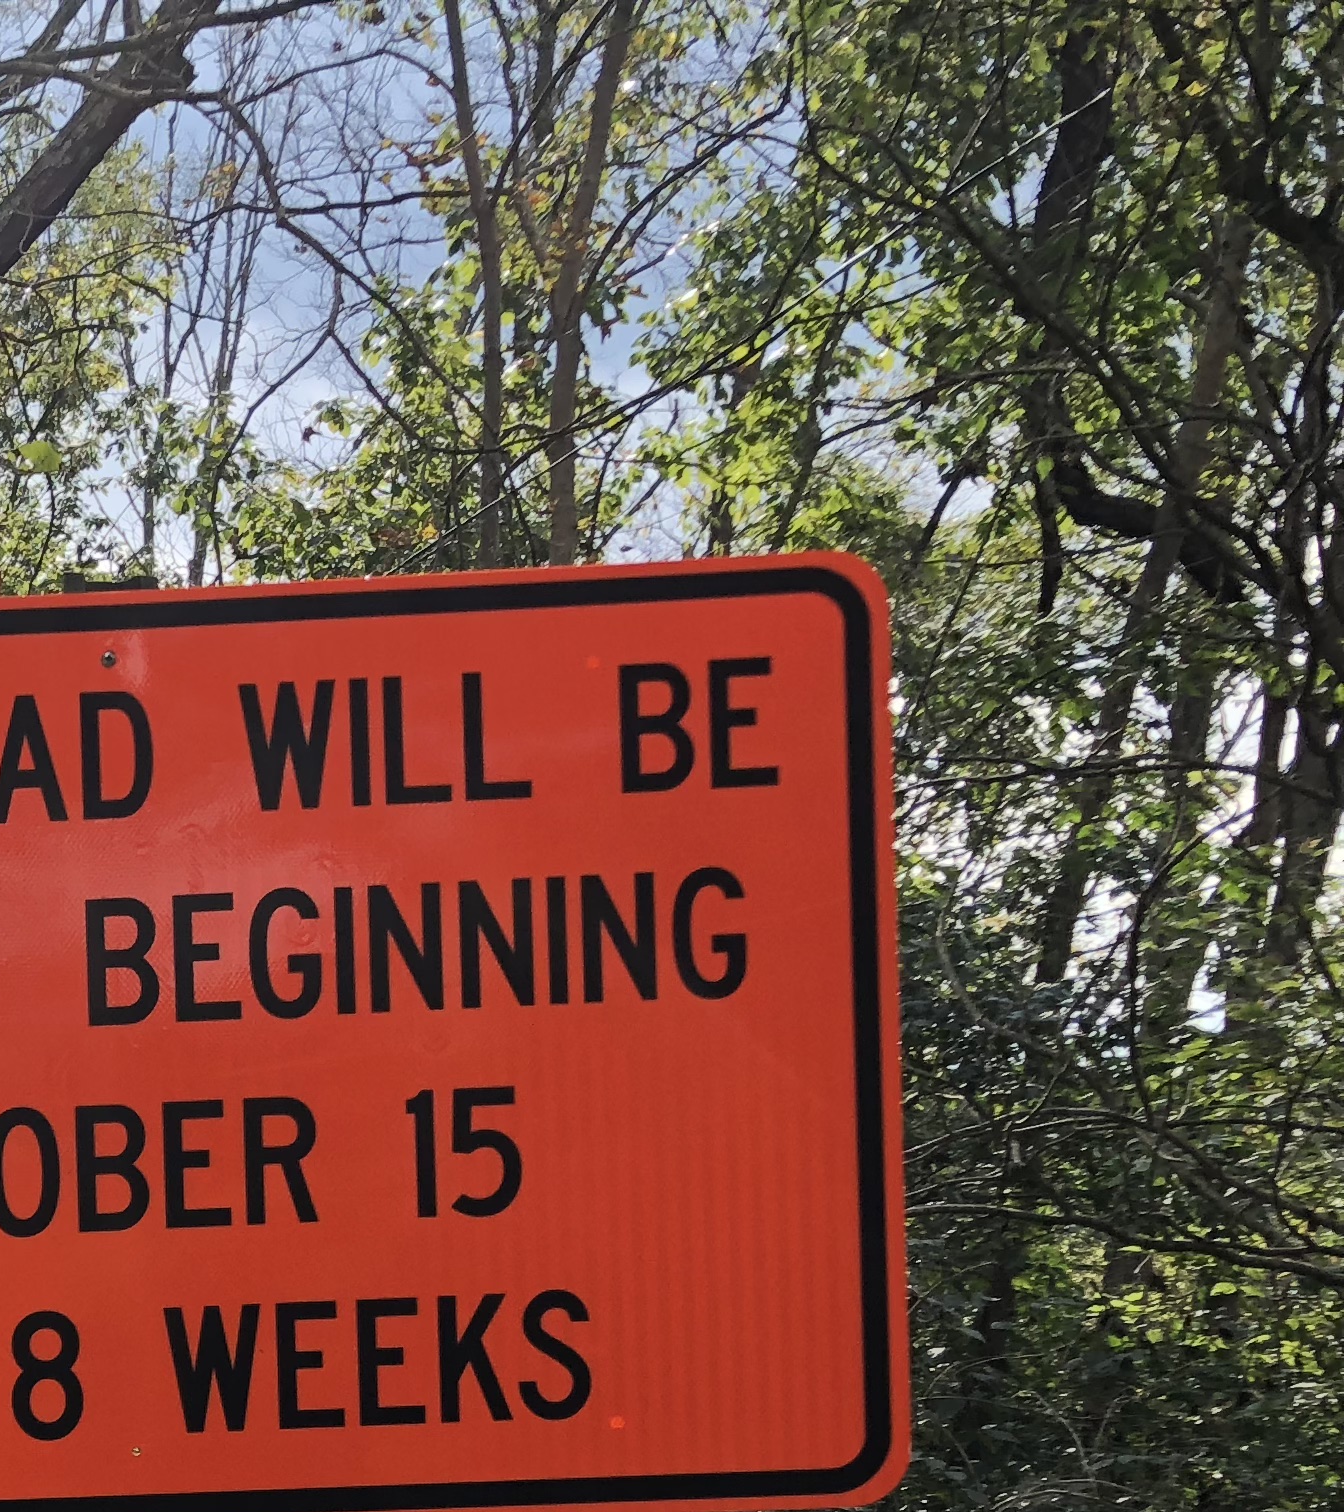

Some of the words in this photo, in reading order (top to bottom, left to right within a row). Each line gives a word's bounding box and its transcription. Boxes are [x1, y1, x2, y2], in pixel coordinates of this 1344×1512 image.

[237, 671, 534, 812] WILL
[617, 655, 781, 795] BE
[84, 865, 749, 1027] BEGINNING
[405, 1085, 524, 1219] 15
[10, 1309, 85, 1442] 8
[162, 1288, 593, 1434] WEEKS
